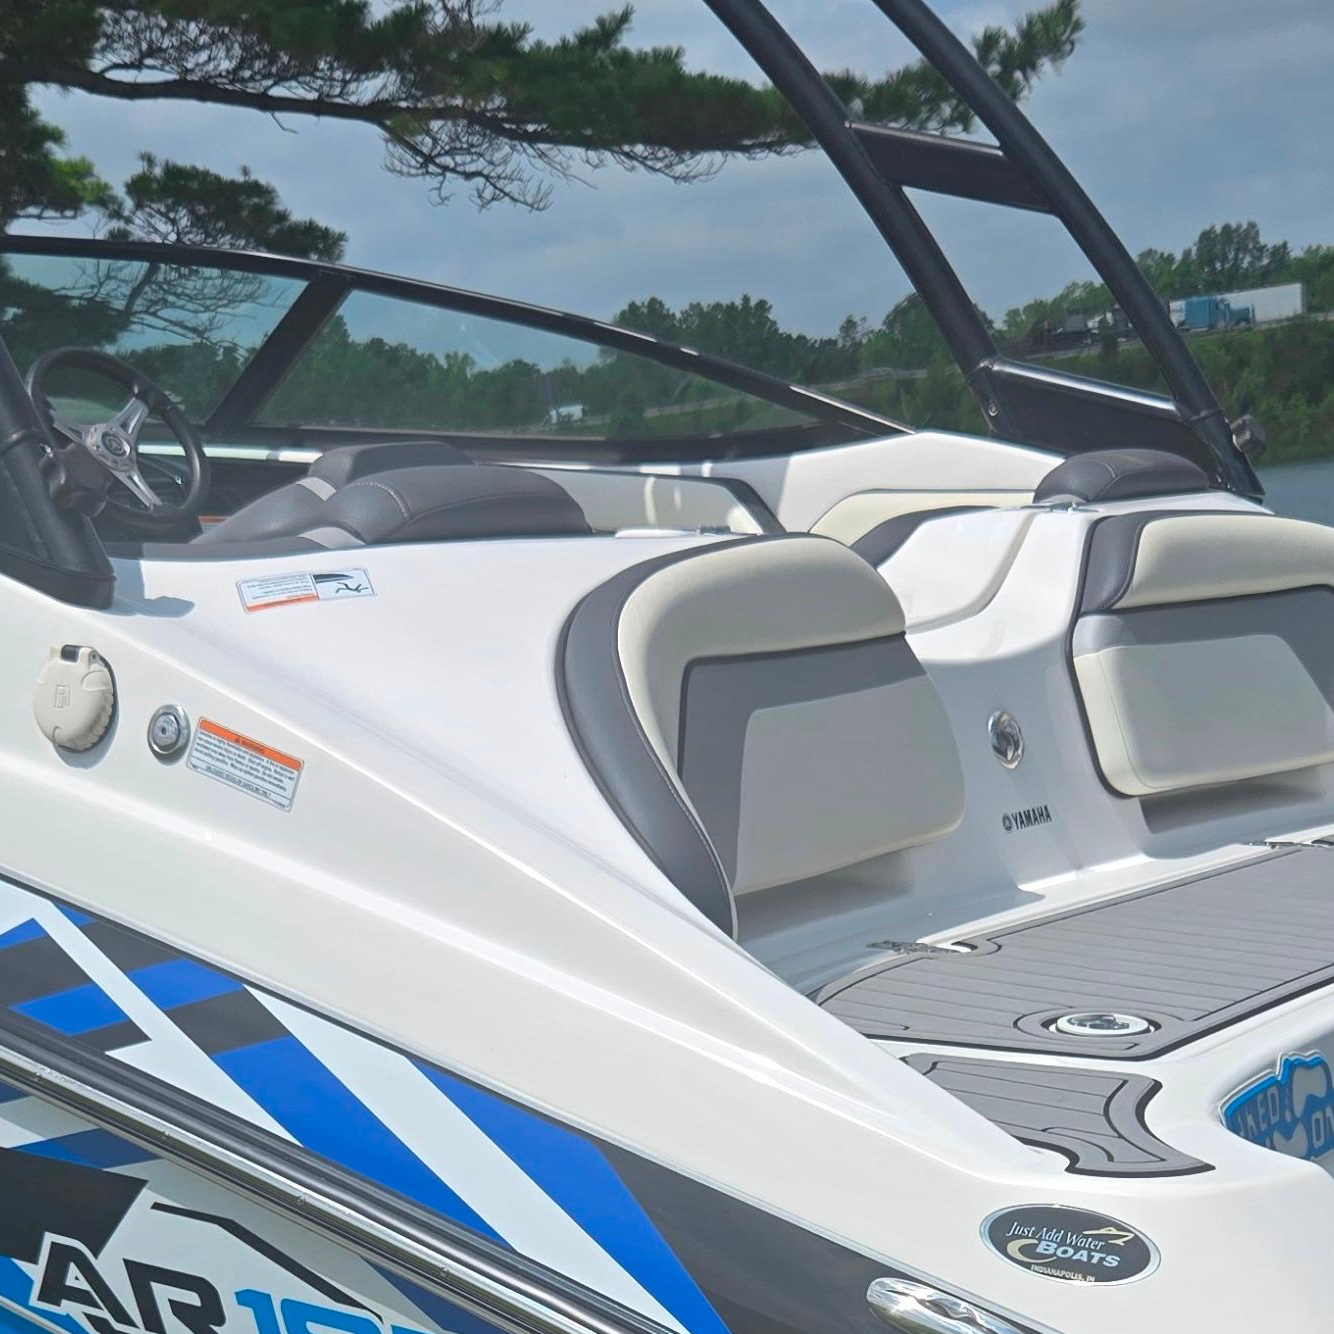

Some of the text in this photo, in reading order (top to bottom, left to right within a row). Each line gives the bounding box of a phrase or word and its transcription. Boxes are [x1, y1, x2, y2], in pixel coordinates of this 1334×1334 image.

[1010, 804, 1053, 830] YAMAHA
[1005, 1221, 1106, 1252] Just Add Water
[1035, 1240, 1121, 1268] BOATS
